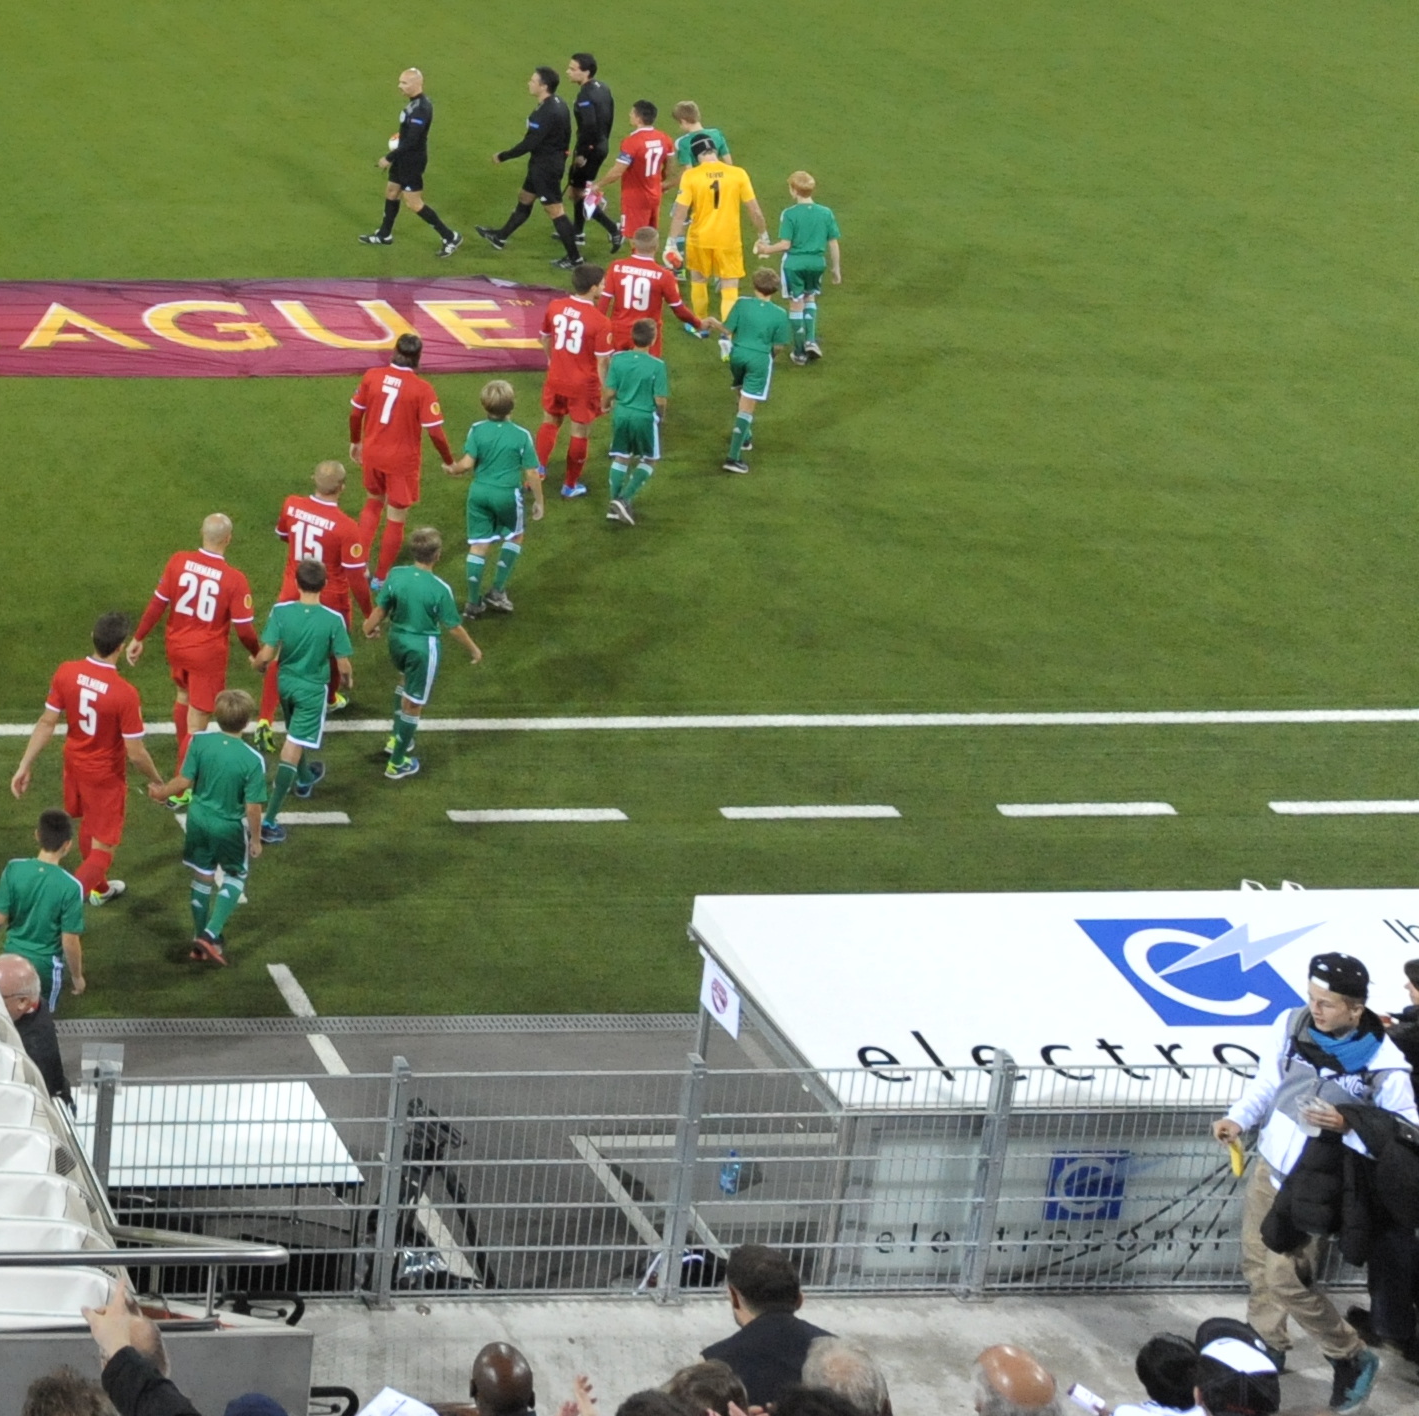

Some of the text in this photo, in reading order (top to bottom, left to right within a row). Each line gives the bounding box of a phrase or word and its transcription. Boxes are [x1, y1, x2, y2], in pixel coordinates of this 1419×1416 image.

[645, 147, 663, 177] 17
[709, 180, 720, 210] 1
[620, 274, 651, 311] 19
[553, 314, 584, 354] 33
[380, 385, 398, 424] 7
[290, 521, 324, 562] 15
[174, 571, 220, 622] 26
[78, 687, 98, 736] 5
[856, 1030, 1261, 1083] electro
[875, 1223, 1230, 1254] eletrocontr
